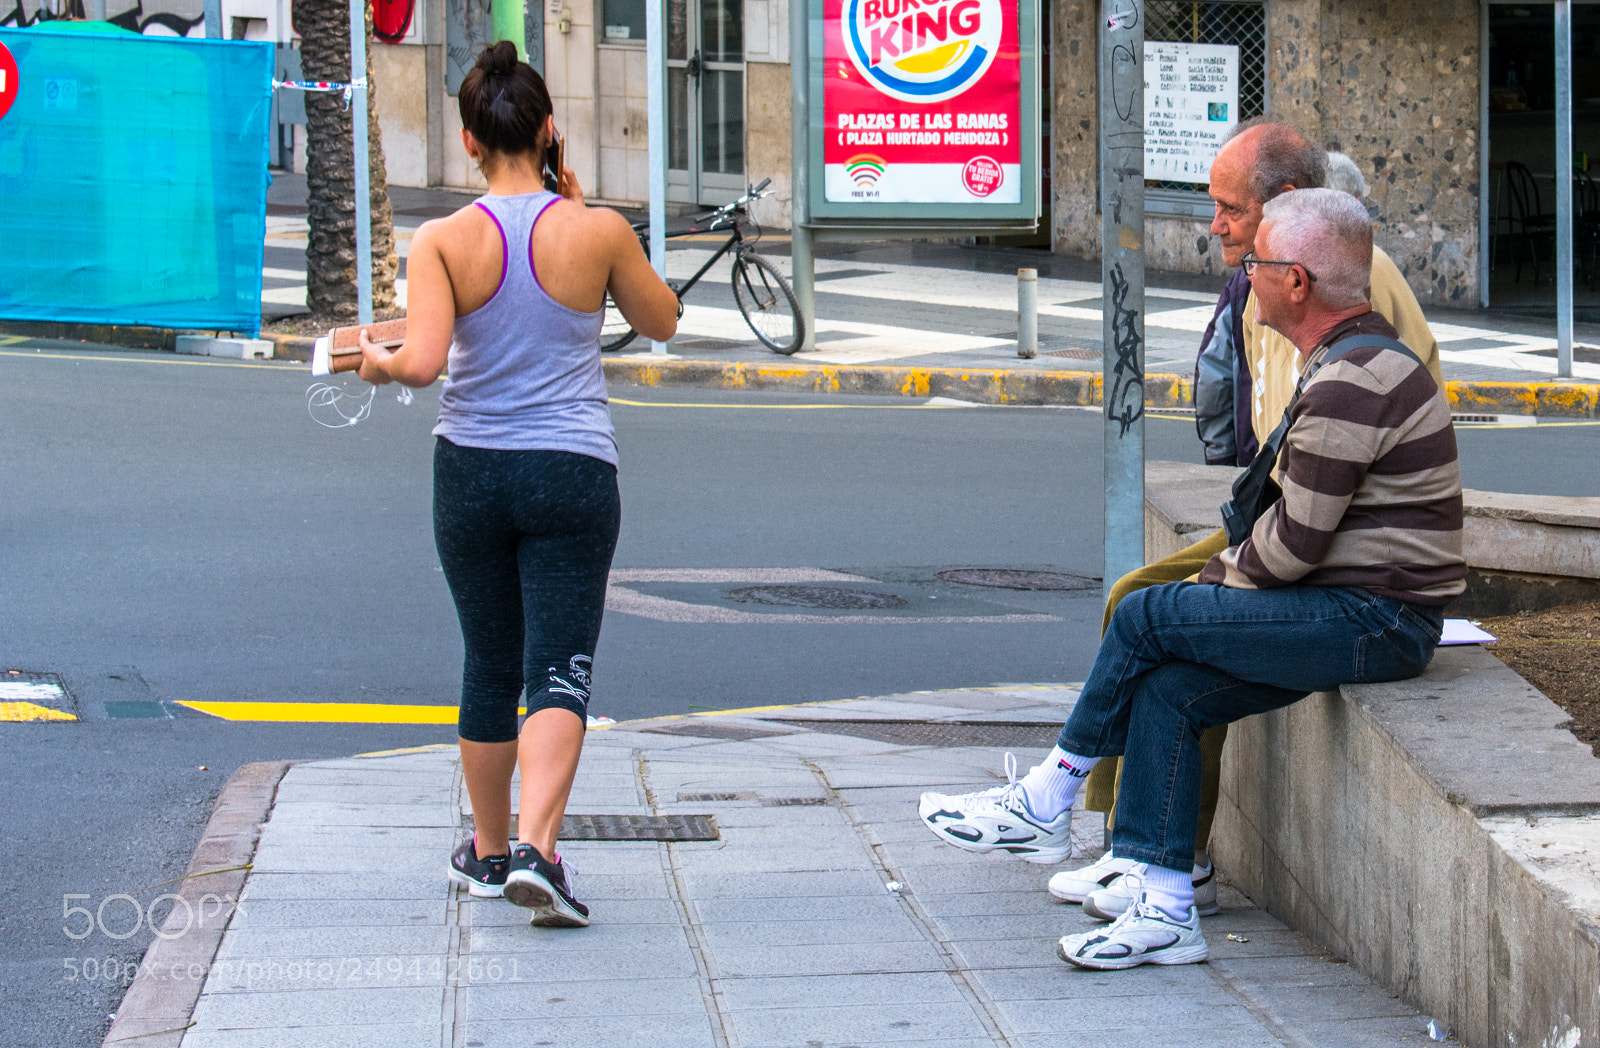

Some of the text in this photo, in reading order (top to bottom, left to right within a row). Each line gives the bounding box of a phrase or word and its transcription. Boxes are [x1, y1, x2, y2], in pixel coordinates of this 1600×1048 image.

[870, 0, 981, 66] KING
[838, 114, 1008, 129] PLAZAS DE LAS RANAS
[847, 132, 883, 145] PLAZA
[886, 132, 941, 145] HURTADO
[944, 132, 1000, 145] MENDOZA
[969, 165, 999, 177] TU BEBIDA
[971, 173, 993, 184] GRATIS
[1057, 759, 1091, 778] FILA
